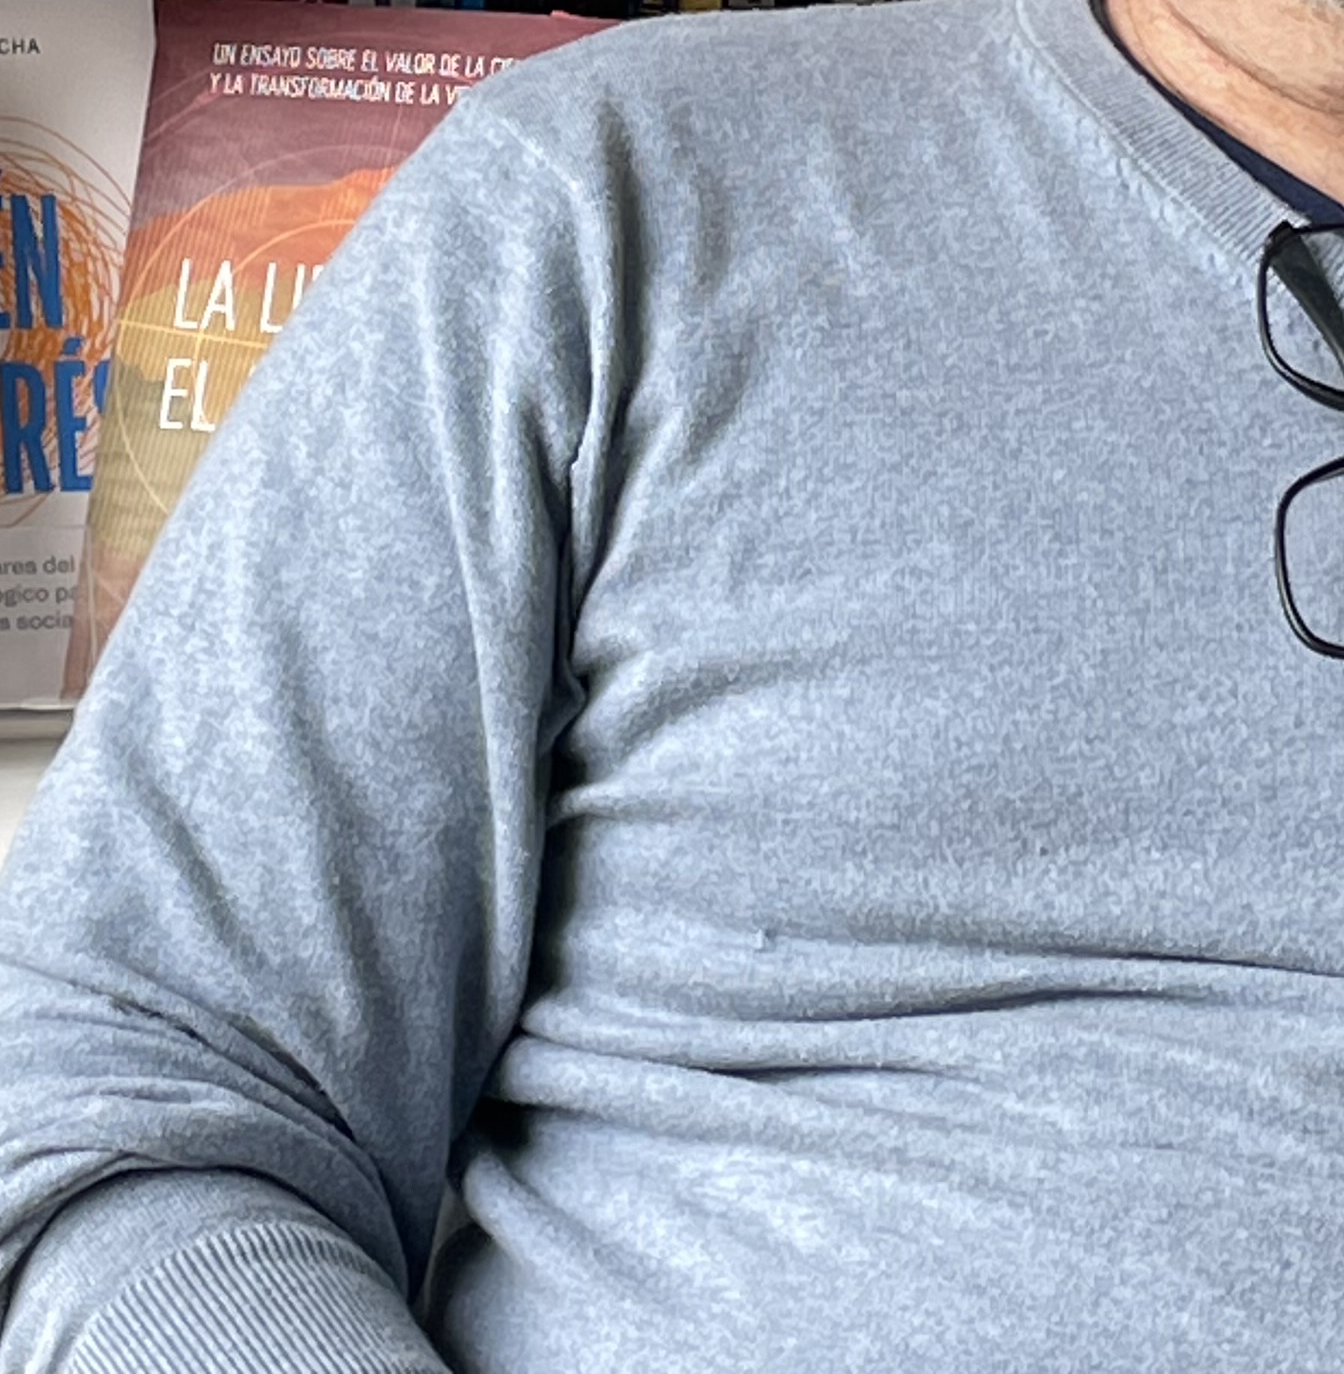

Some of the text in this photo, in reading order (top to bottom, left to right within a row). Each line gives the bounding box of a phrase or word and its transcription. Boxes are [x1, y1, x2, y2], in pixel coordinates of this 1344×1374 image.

[213, 42, 487, 78] UN ENSAYO SOBRE EL VALOR DE LA
[209, 73, 441, 106] Y LA TRANSFORMACIÓN DE LA
[173, 256, 237, 332] LA
[158, 356, 216, 431] EL
